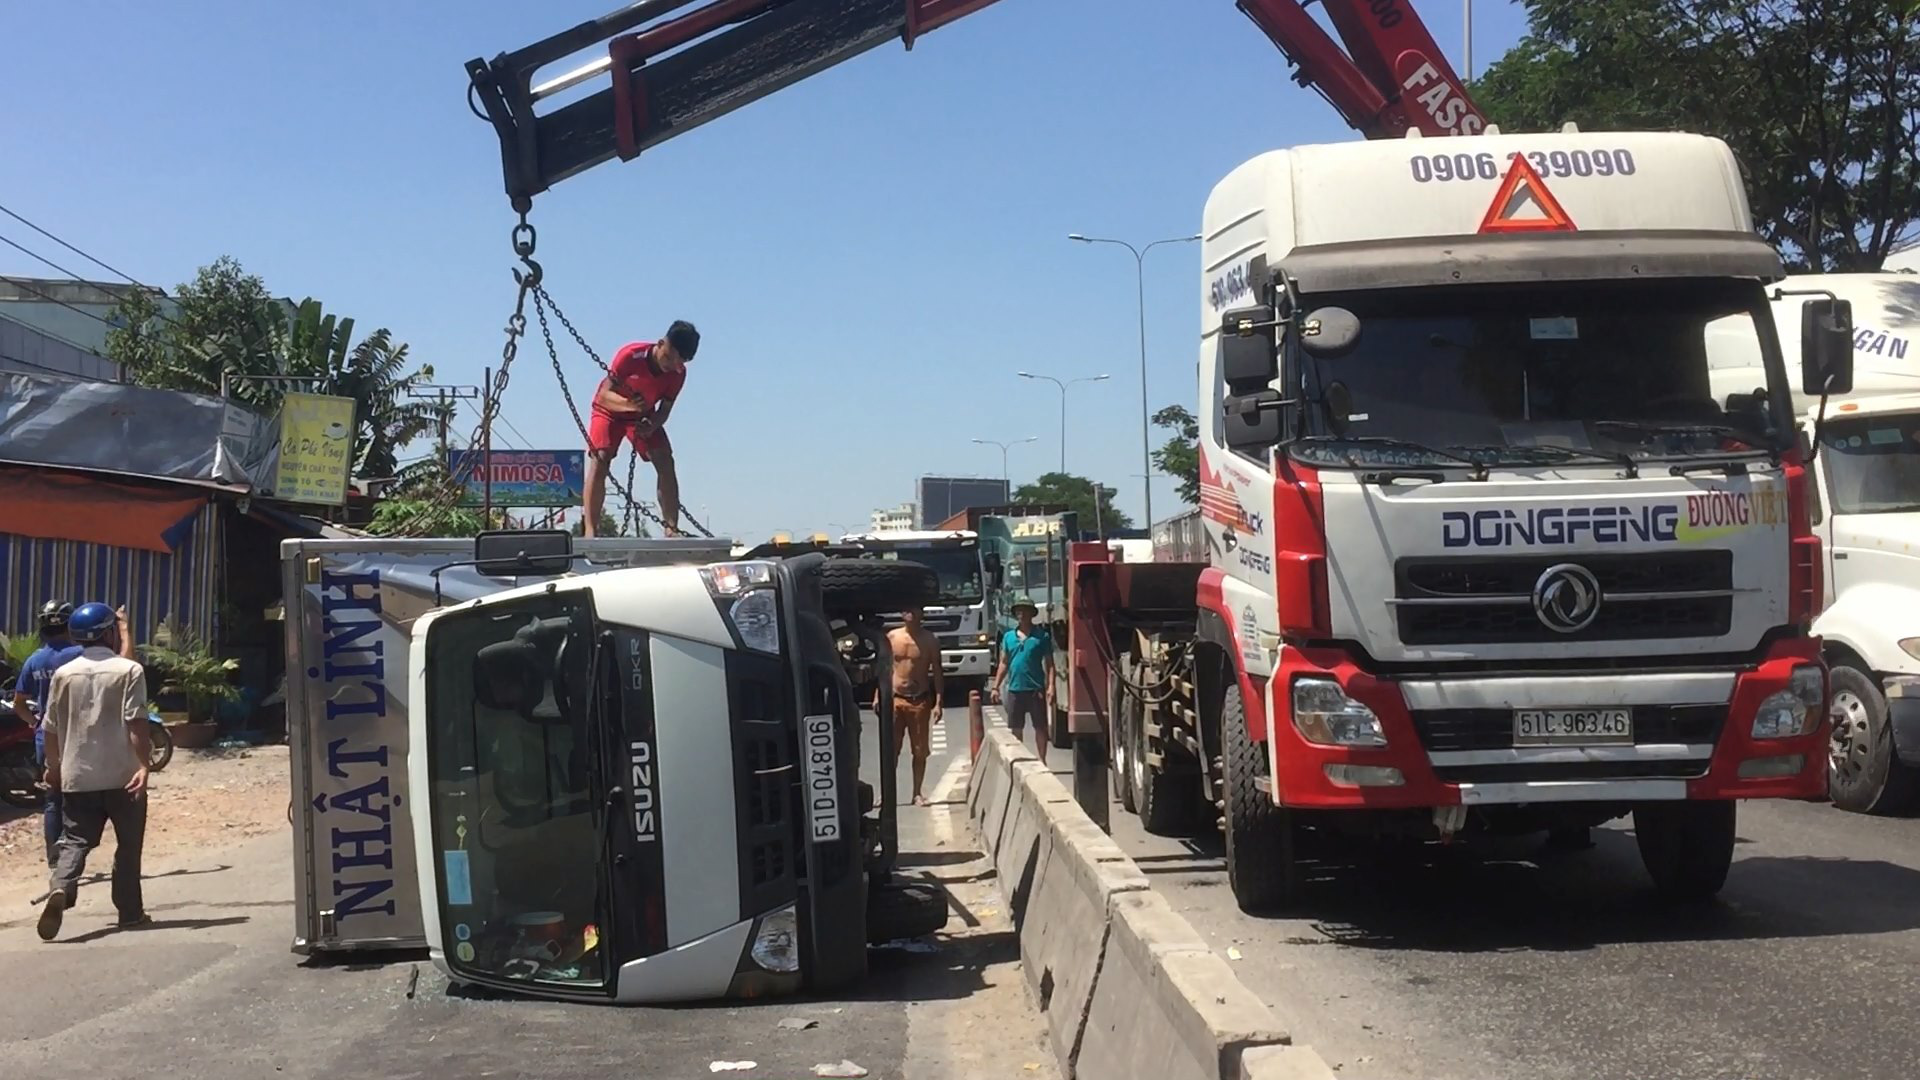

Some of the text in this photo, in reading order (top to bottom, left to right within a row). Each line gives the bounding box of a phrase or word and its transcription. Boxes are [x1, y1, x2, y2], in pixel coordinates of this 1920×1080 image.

[1411, 149, 1636, 183] 0906.39090
[1852, 327, 1909, 359] GÂN
[1442, 505, 1678, 547] DONGFENG
[631, 742, 655, 842] ISUZU
[312, 737, 402, 921] NHẬT
